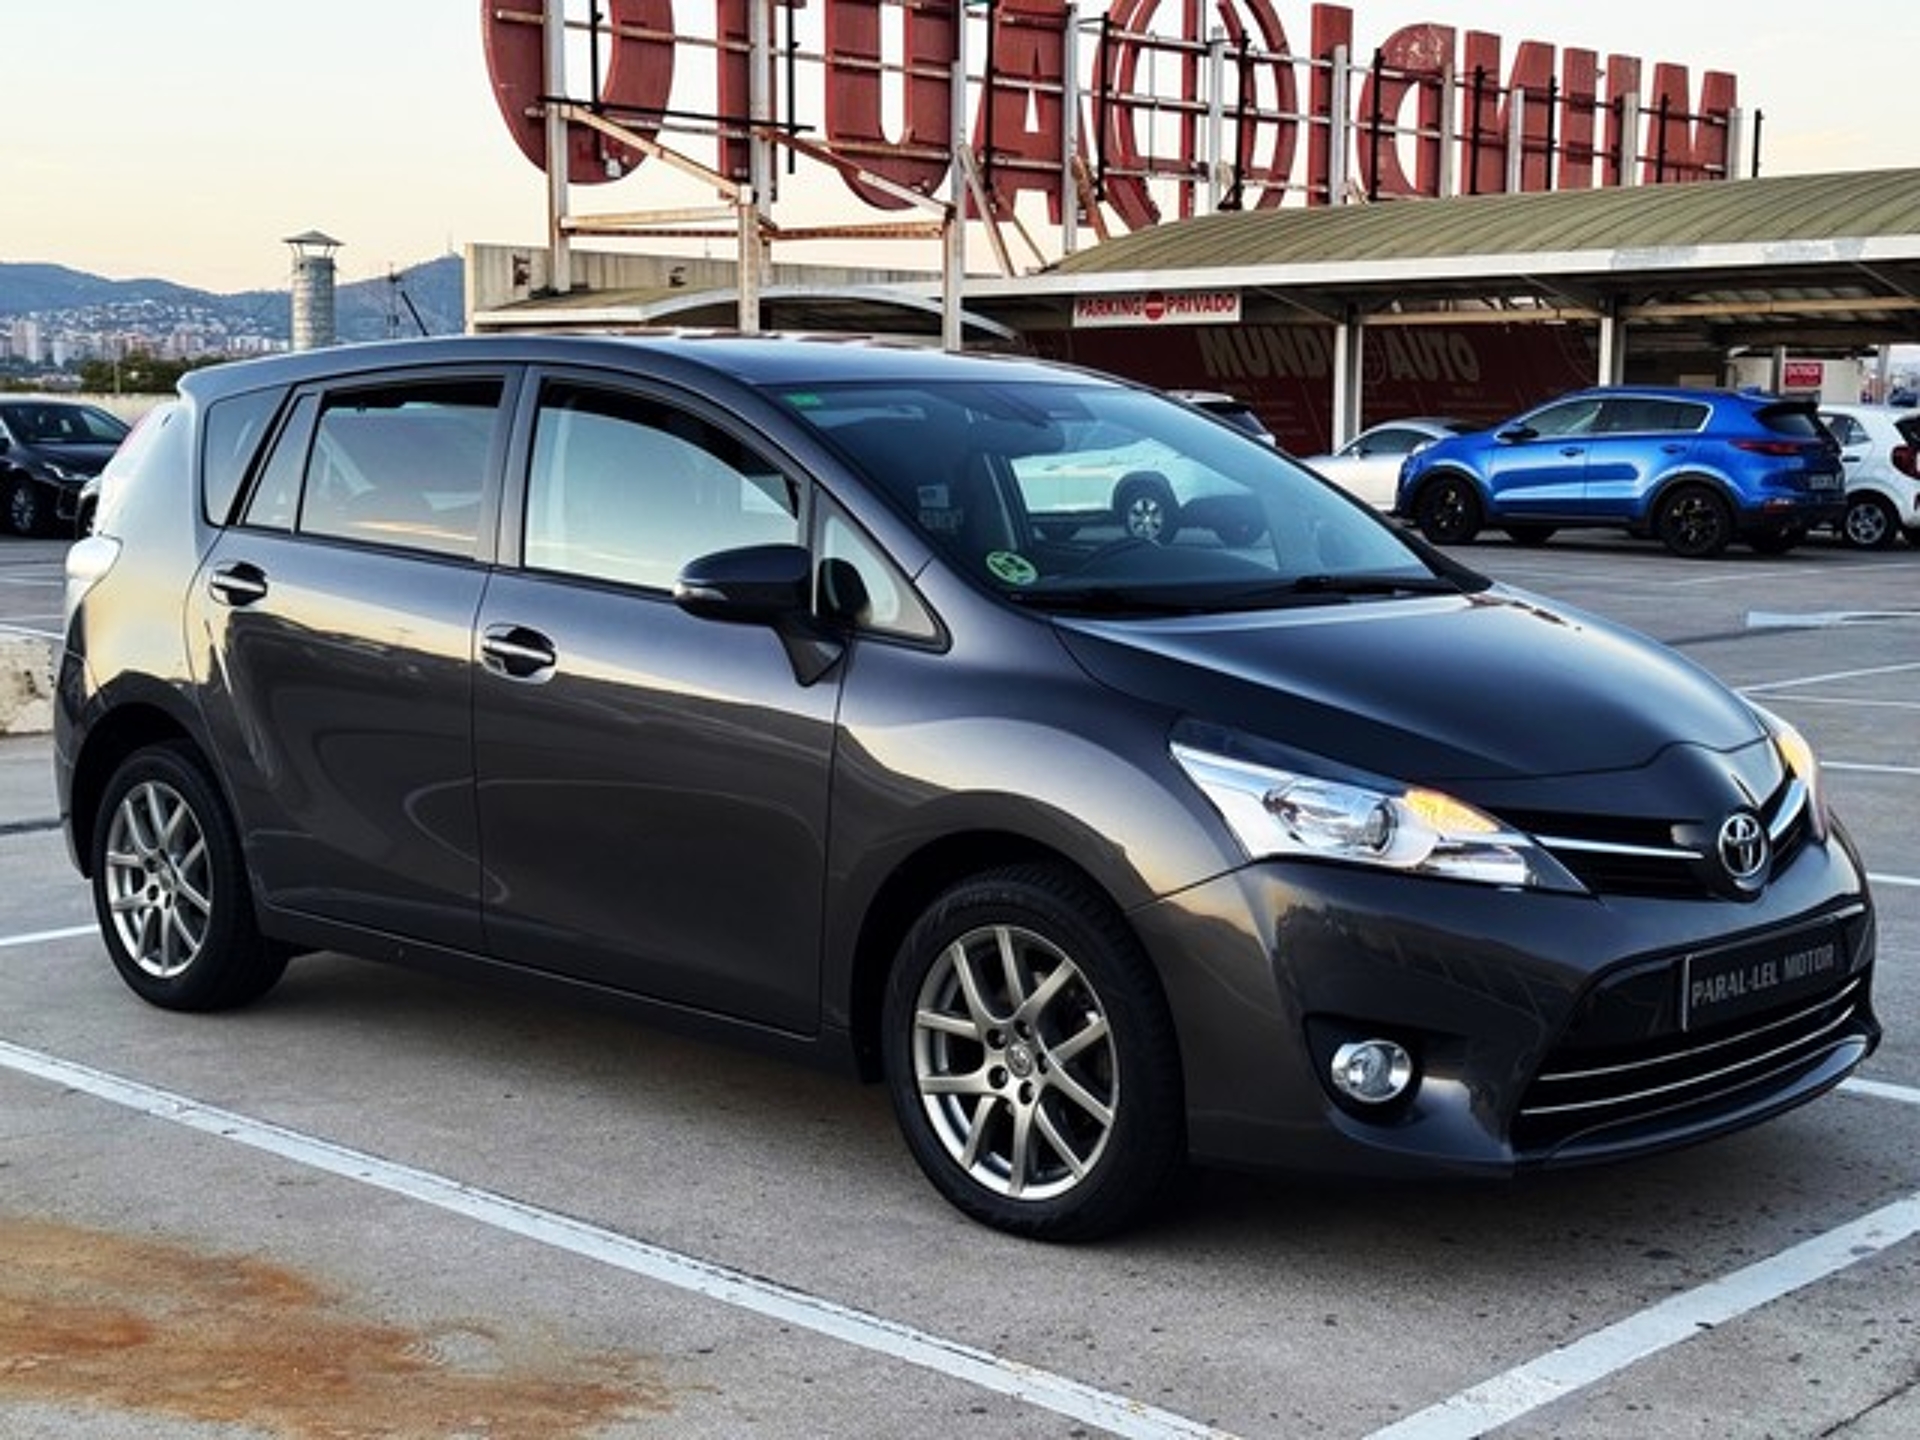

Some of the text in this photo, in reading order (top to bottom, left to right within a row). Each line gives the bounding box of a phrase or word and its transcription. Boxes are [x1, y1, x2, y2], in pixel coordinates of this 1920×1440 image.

[1077, 292, 1236, 317] PARKING PRIVADO
[1383, 328, 1481, 382] AUTO
[1783, 943, 1835, 981] MOTOR
